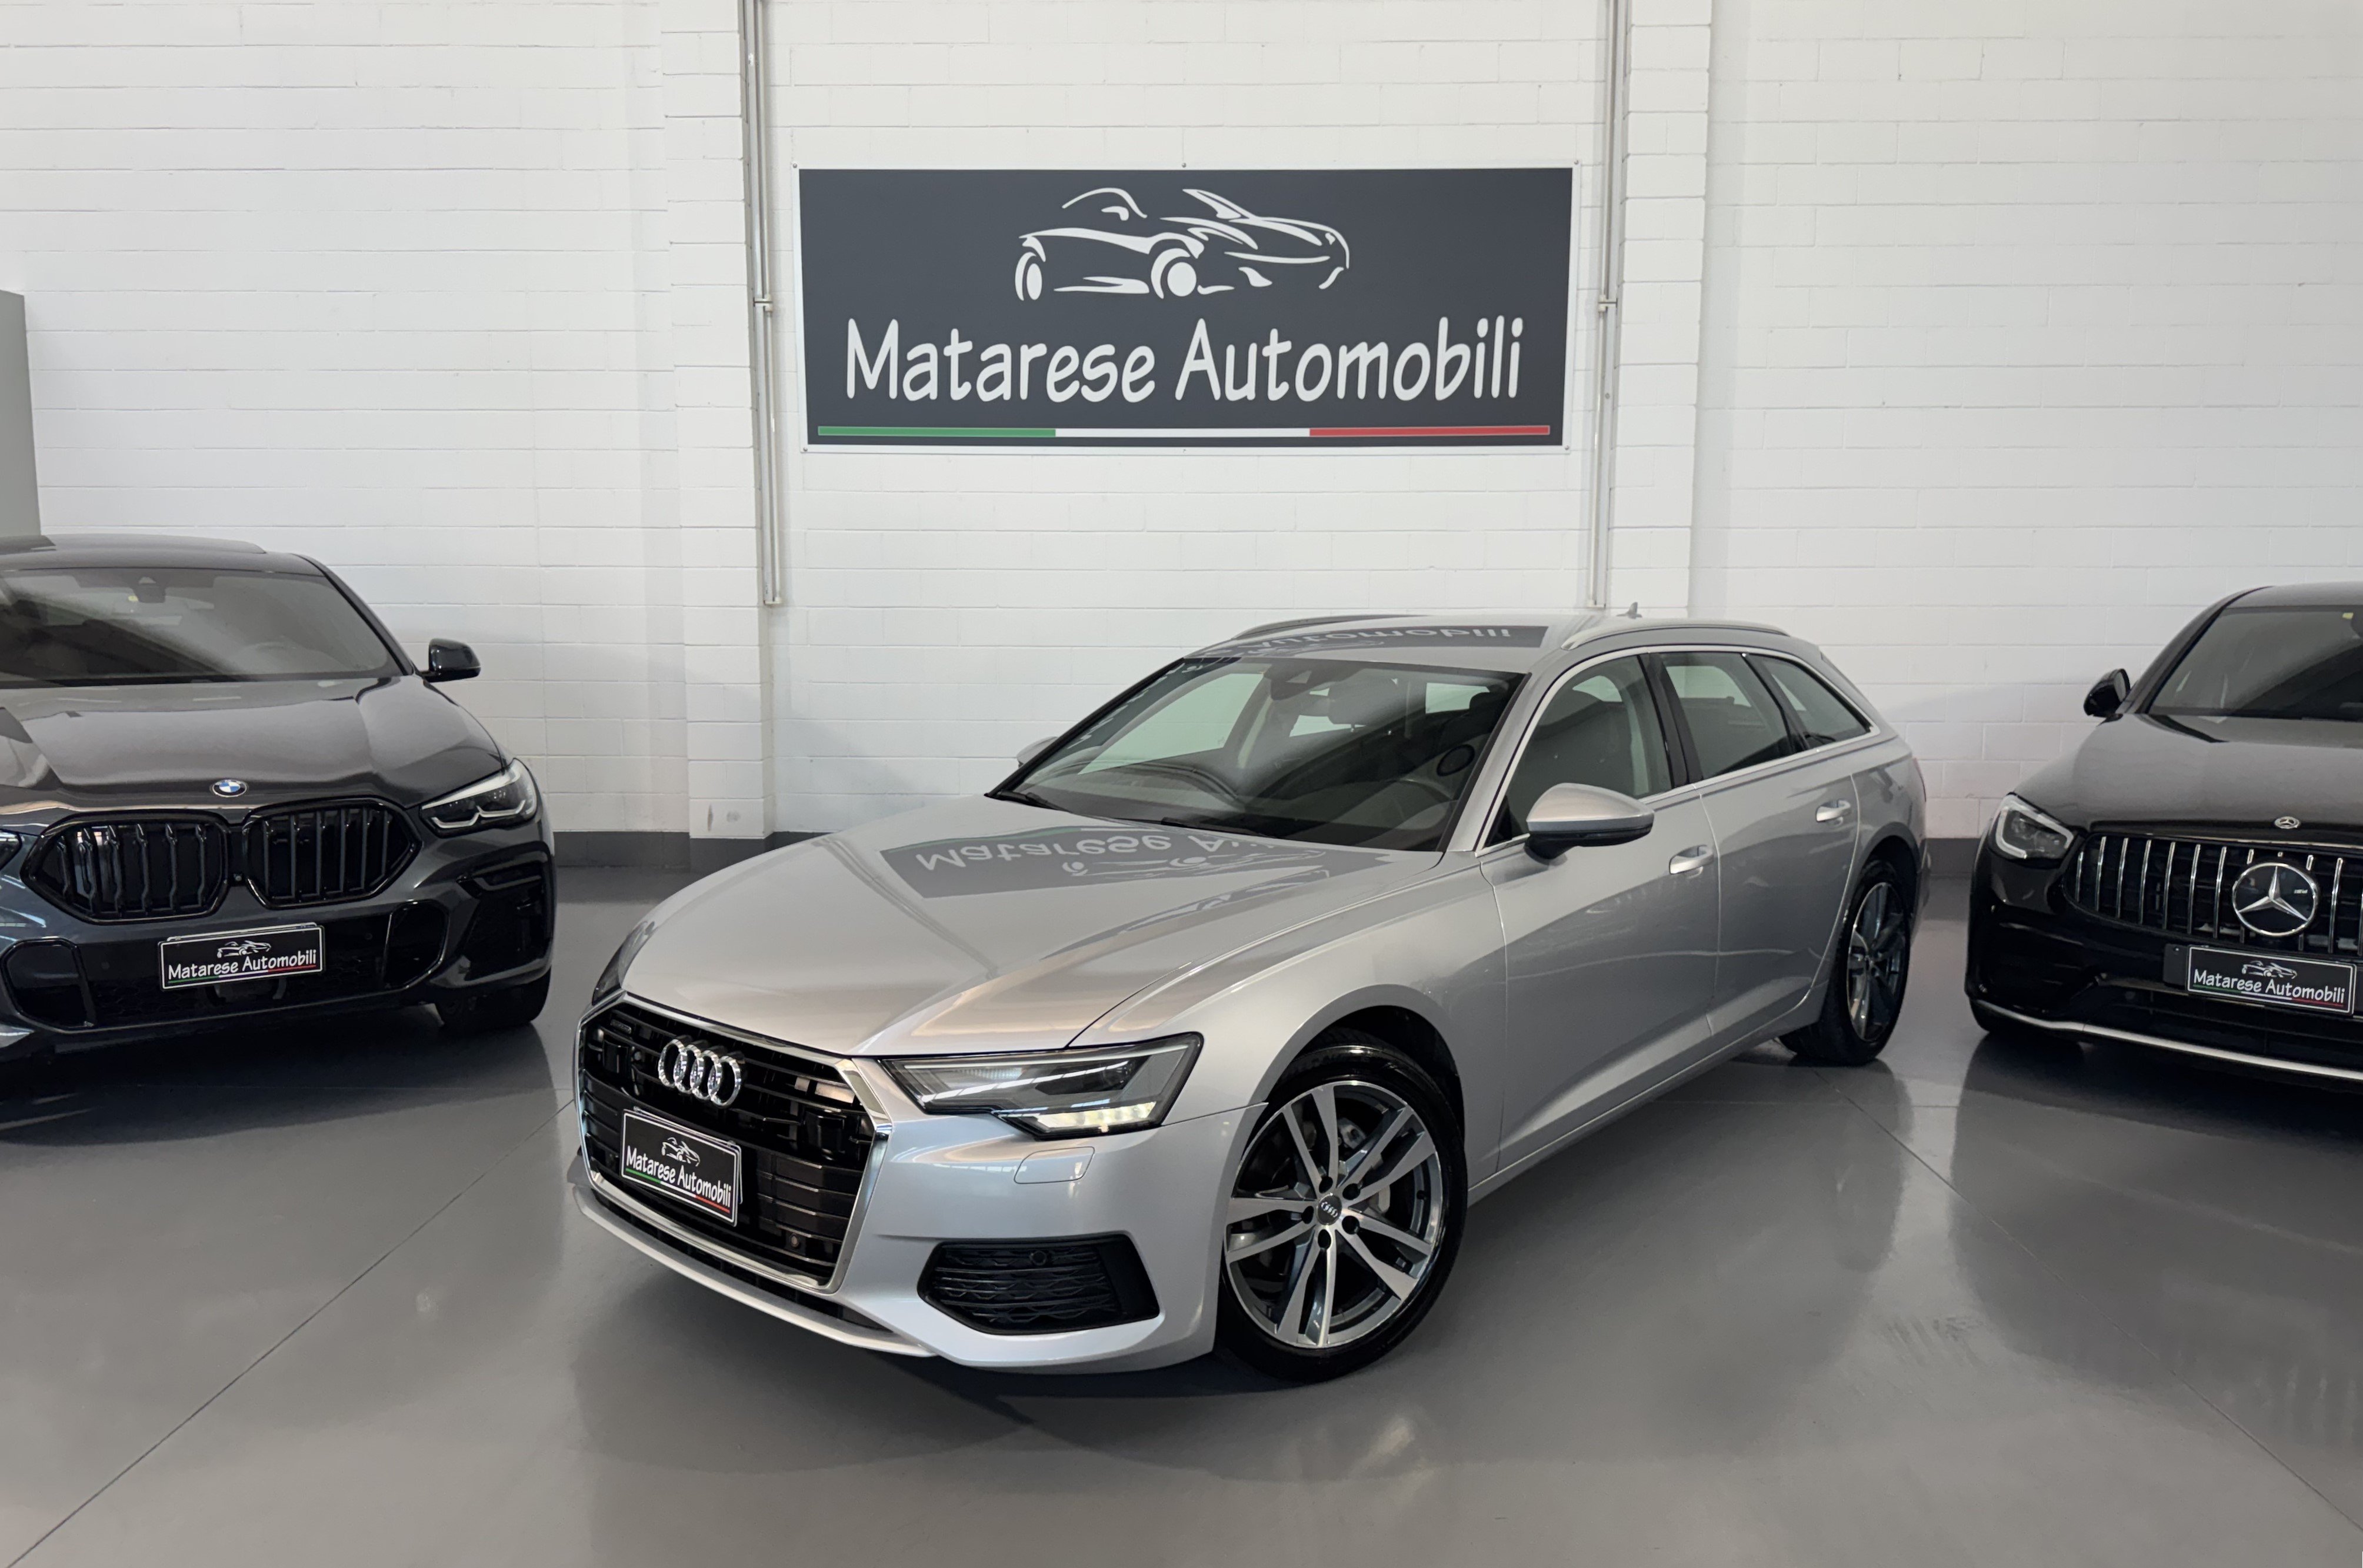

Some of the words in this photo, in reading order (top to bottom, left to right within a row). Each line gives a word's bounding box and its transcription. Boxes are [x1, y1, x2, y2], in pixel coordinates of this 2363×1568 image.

[845, 318, 1156, 403] Matarese
[1174, 315, 1524, 402] Automobili
[168, 962, 238, 980] Matarese
[242, 949, 316, 971] Automobili
[2192, 969, 2262, 993] Matarese
[2265, 979, 2345, 1003] Automobili
[626, 1145, 676, 1183] Matarese
[677, 1165, 731, 1207] Automobili
